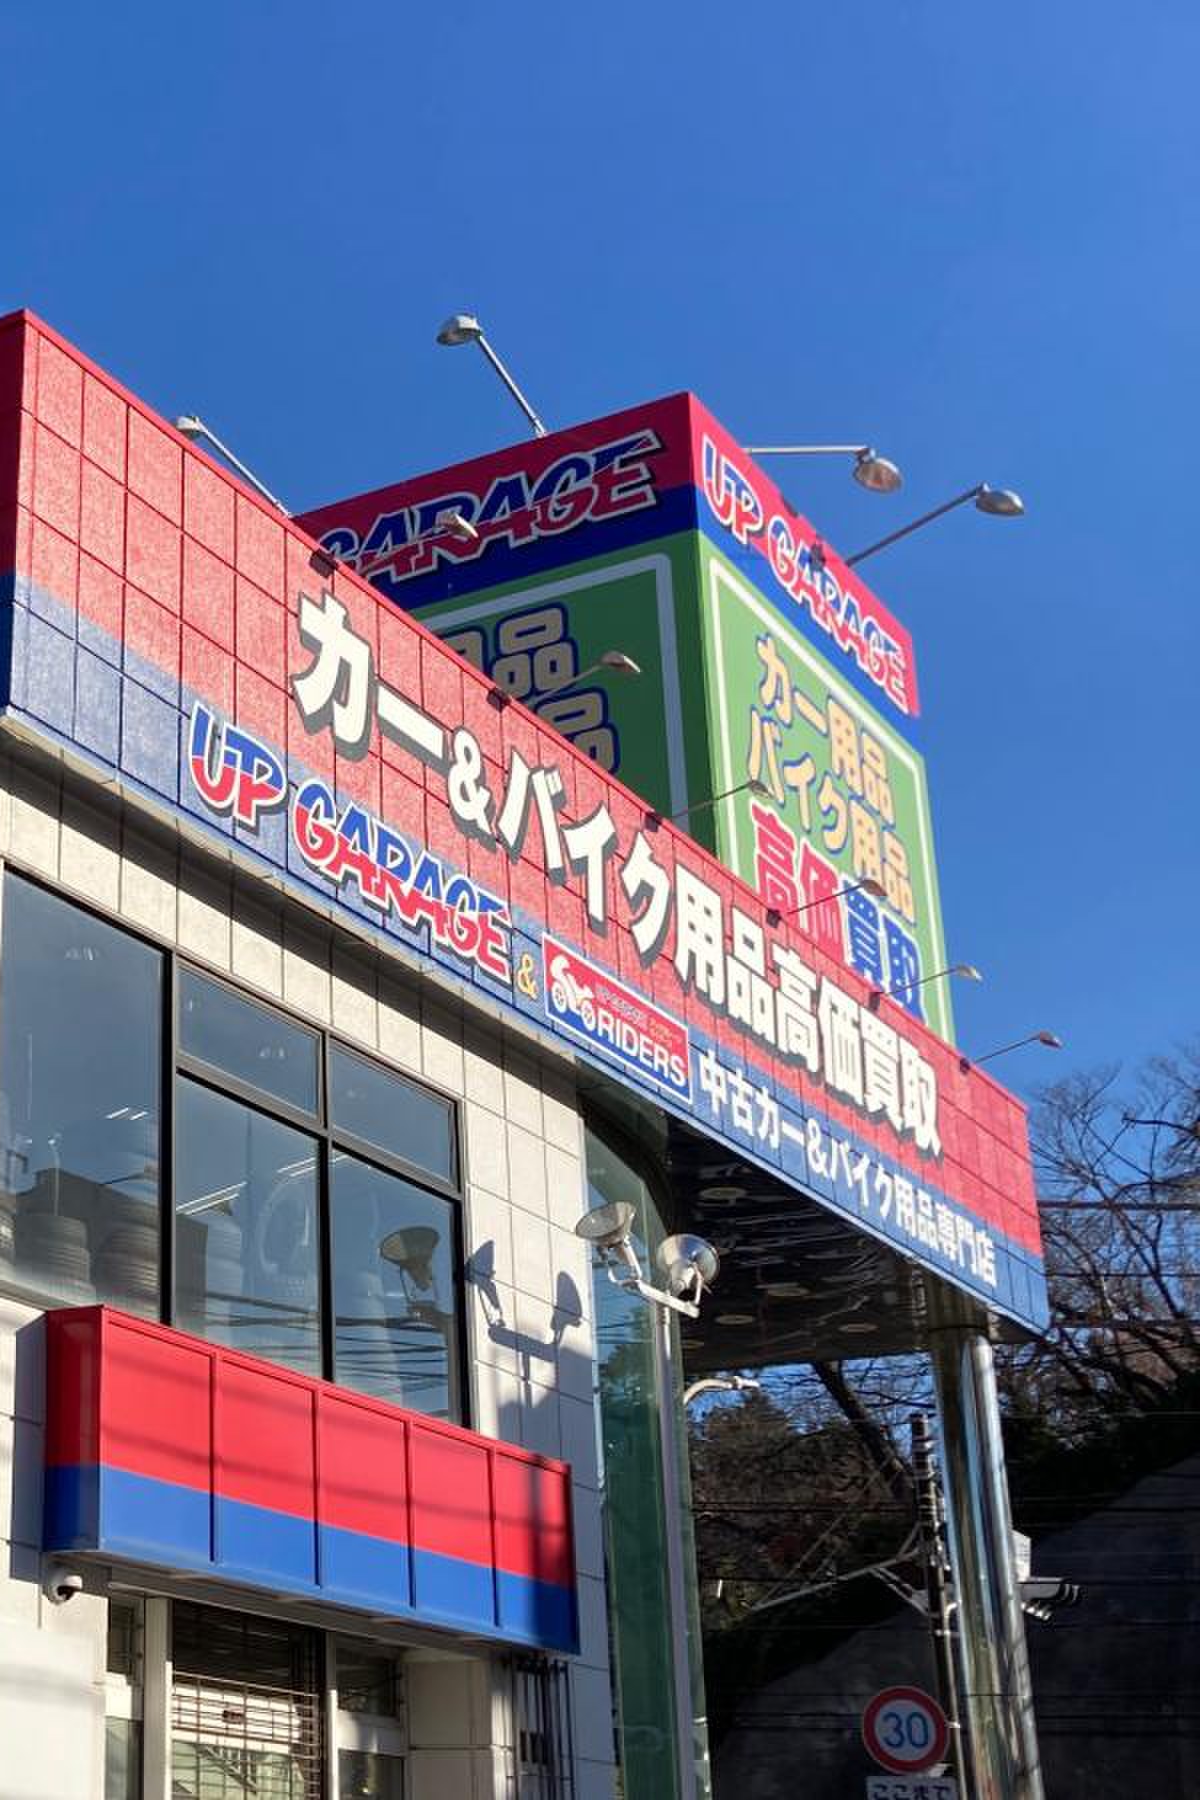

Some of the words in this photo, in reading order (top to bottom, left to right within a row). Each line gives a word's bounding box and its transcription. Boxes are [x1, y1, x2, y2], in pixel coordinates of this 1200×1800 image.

[442, 605, 575, 700] 品
[702, 432, 763, 545] UP
[767, 514, 910, 714] GARAGE
[747, 708, 918, 926] バイク用品
[756, 632, 895, 827] カー用品
[187, 700, 287, 828] UP
[293, 778, 512, 985] GARAGE
[516, 952, 539, 1000] &
[292, 590, 943, 1158] カー&バイク用品高価買取
[596, 1006, 687, 1088] RIDERS
[881, 1711, 930, 1749] 30
